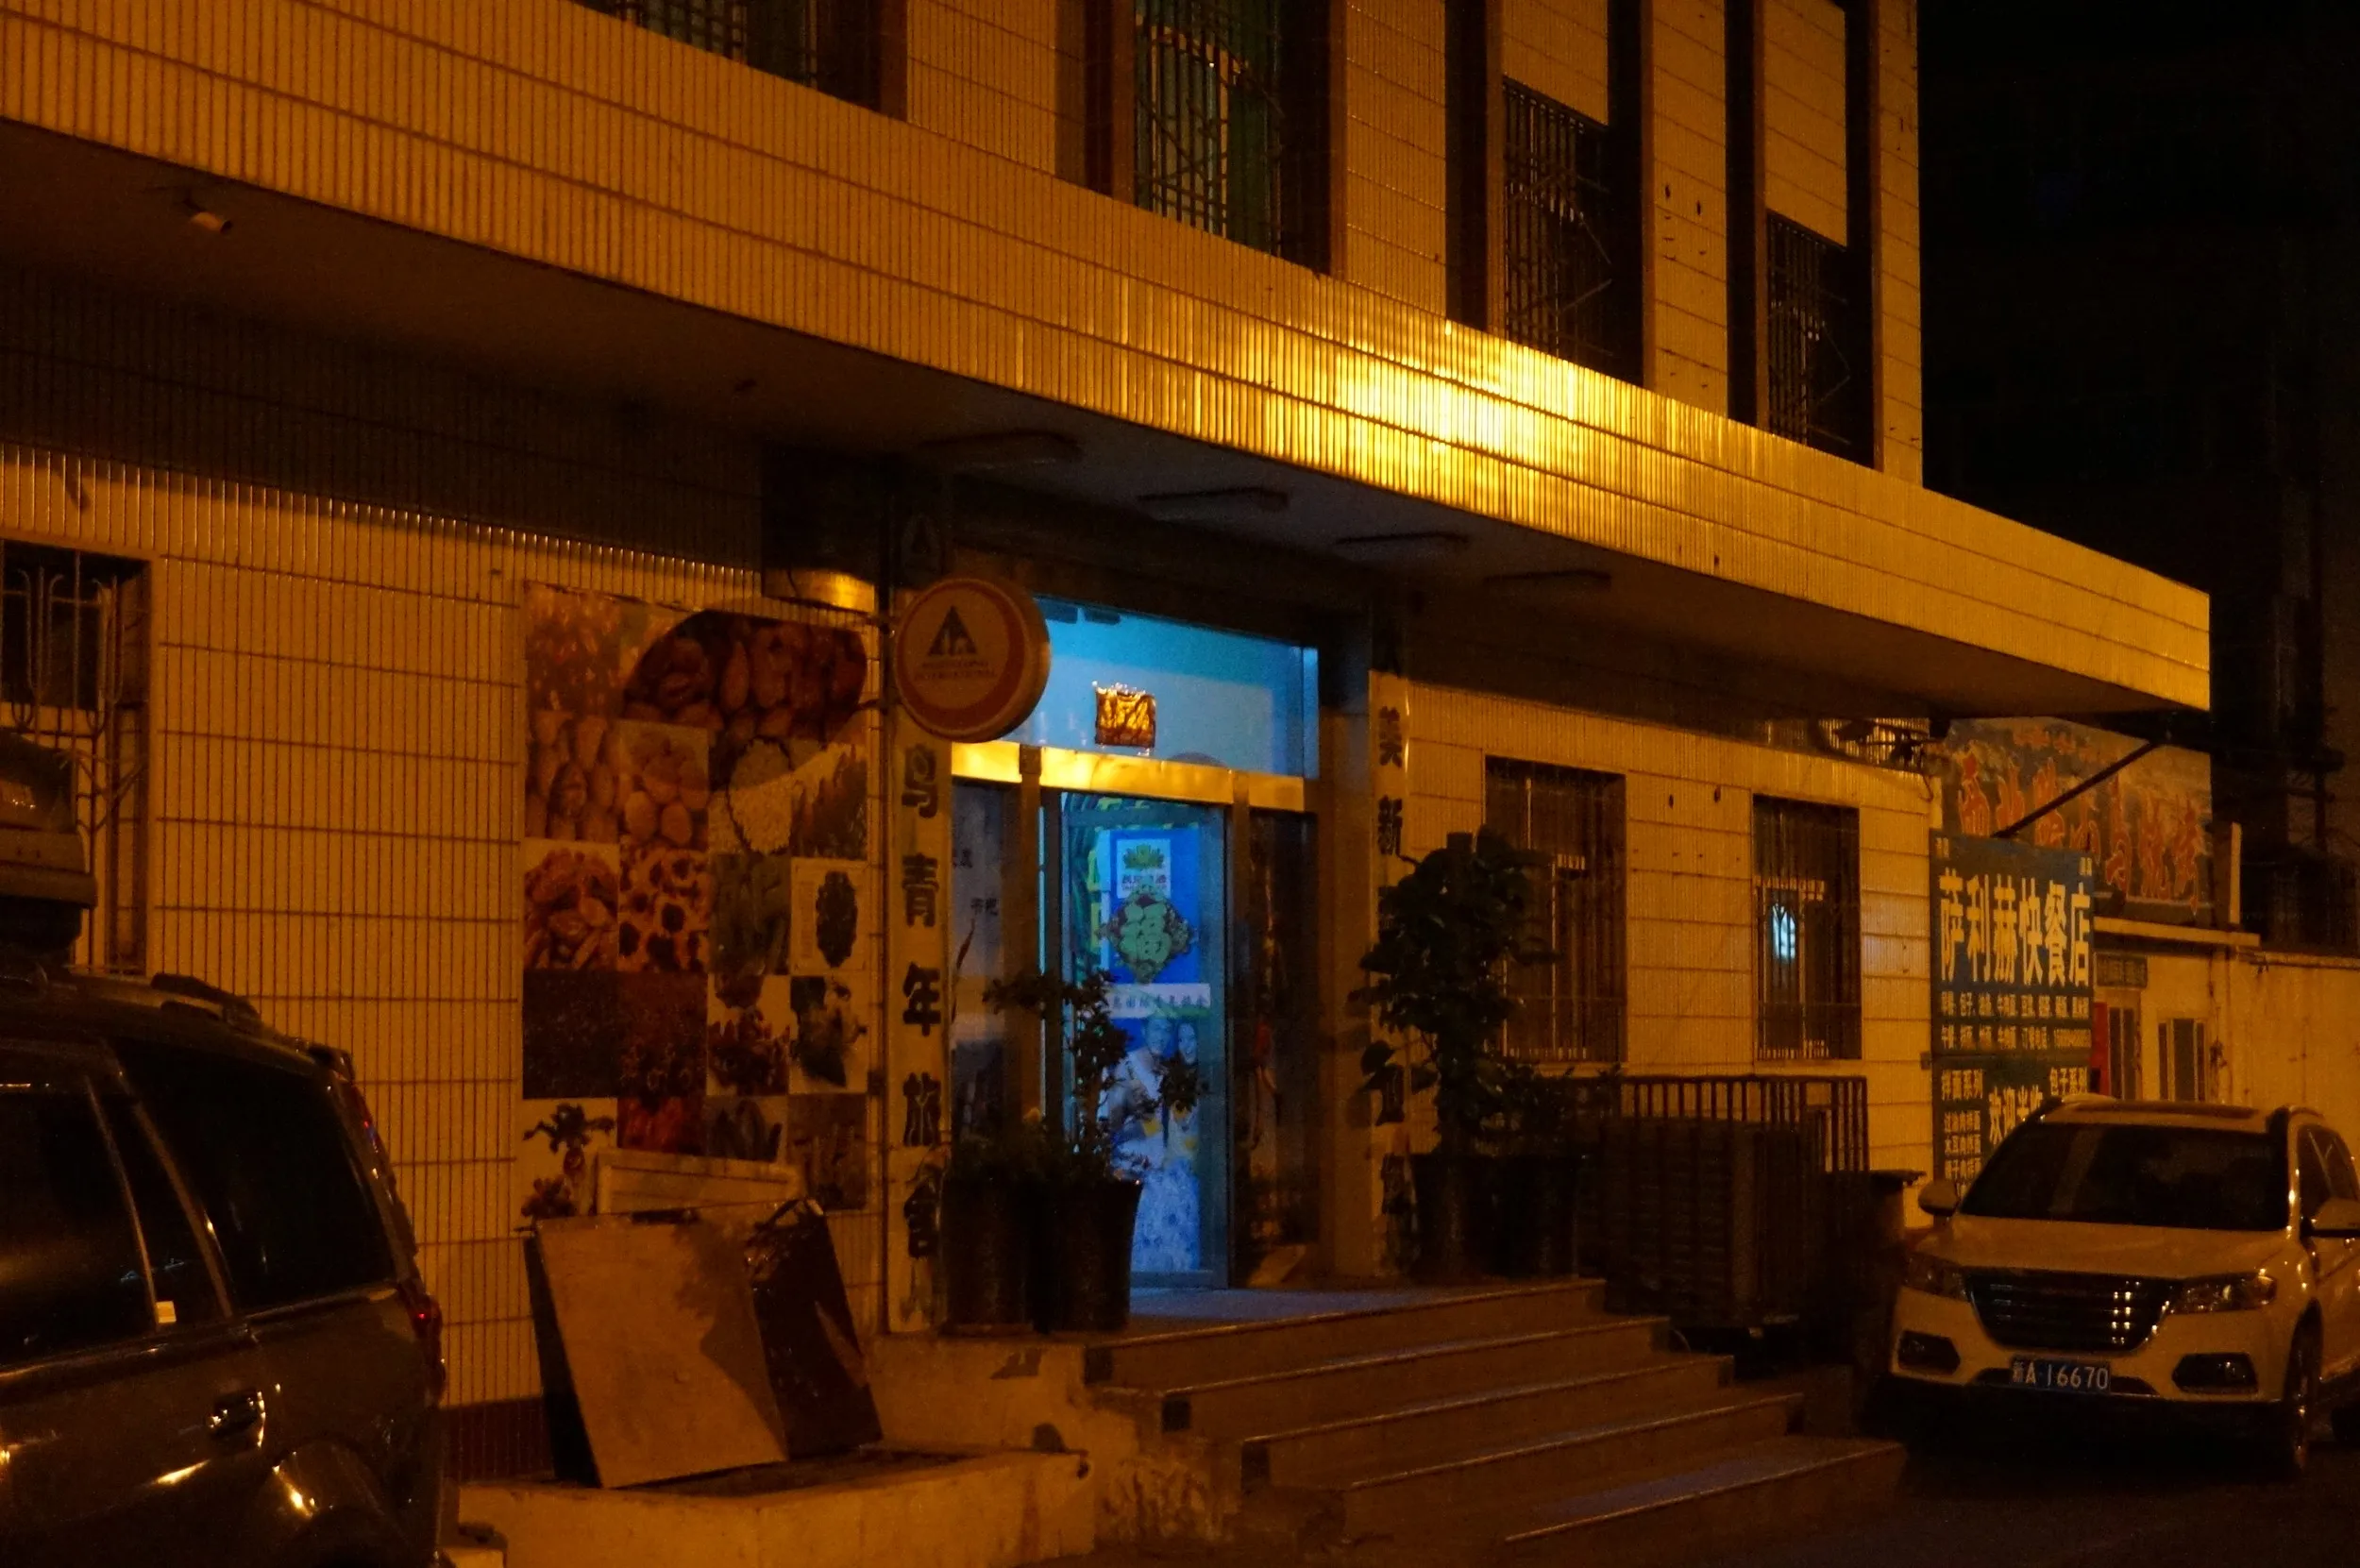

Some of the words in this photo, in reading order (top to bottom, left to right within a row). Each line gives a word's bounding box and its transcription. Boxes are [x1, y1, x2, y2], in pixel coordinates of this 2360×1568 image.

[1938, 867, 2091, 987] 萨利赫快餐店
[1941, 1068, 1983, 1101] 拌面系列
[2049, 1067, 2088, 1096] 包子系列
